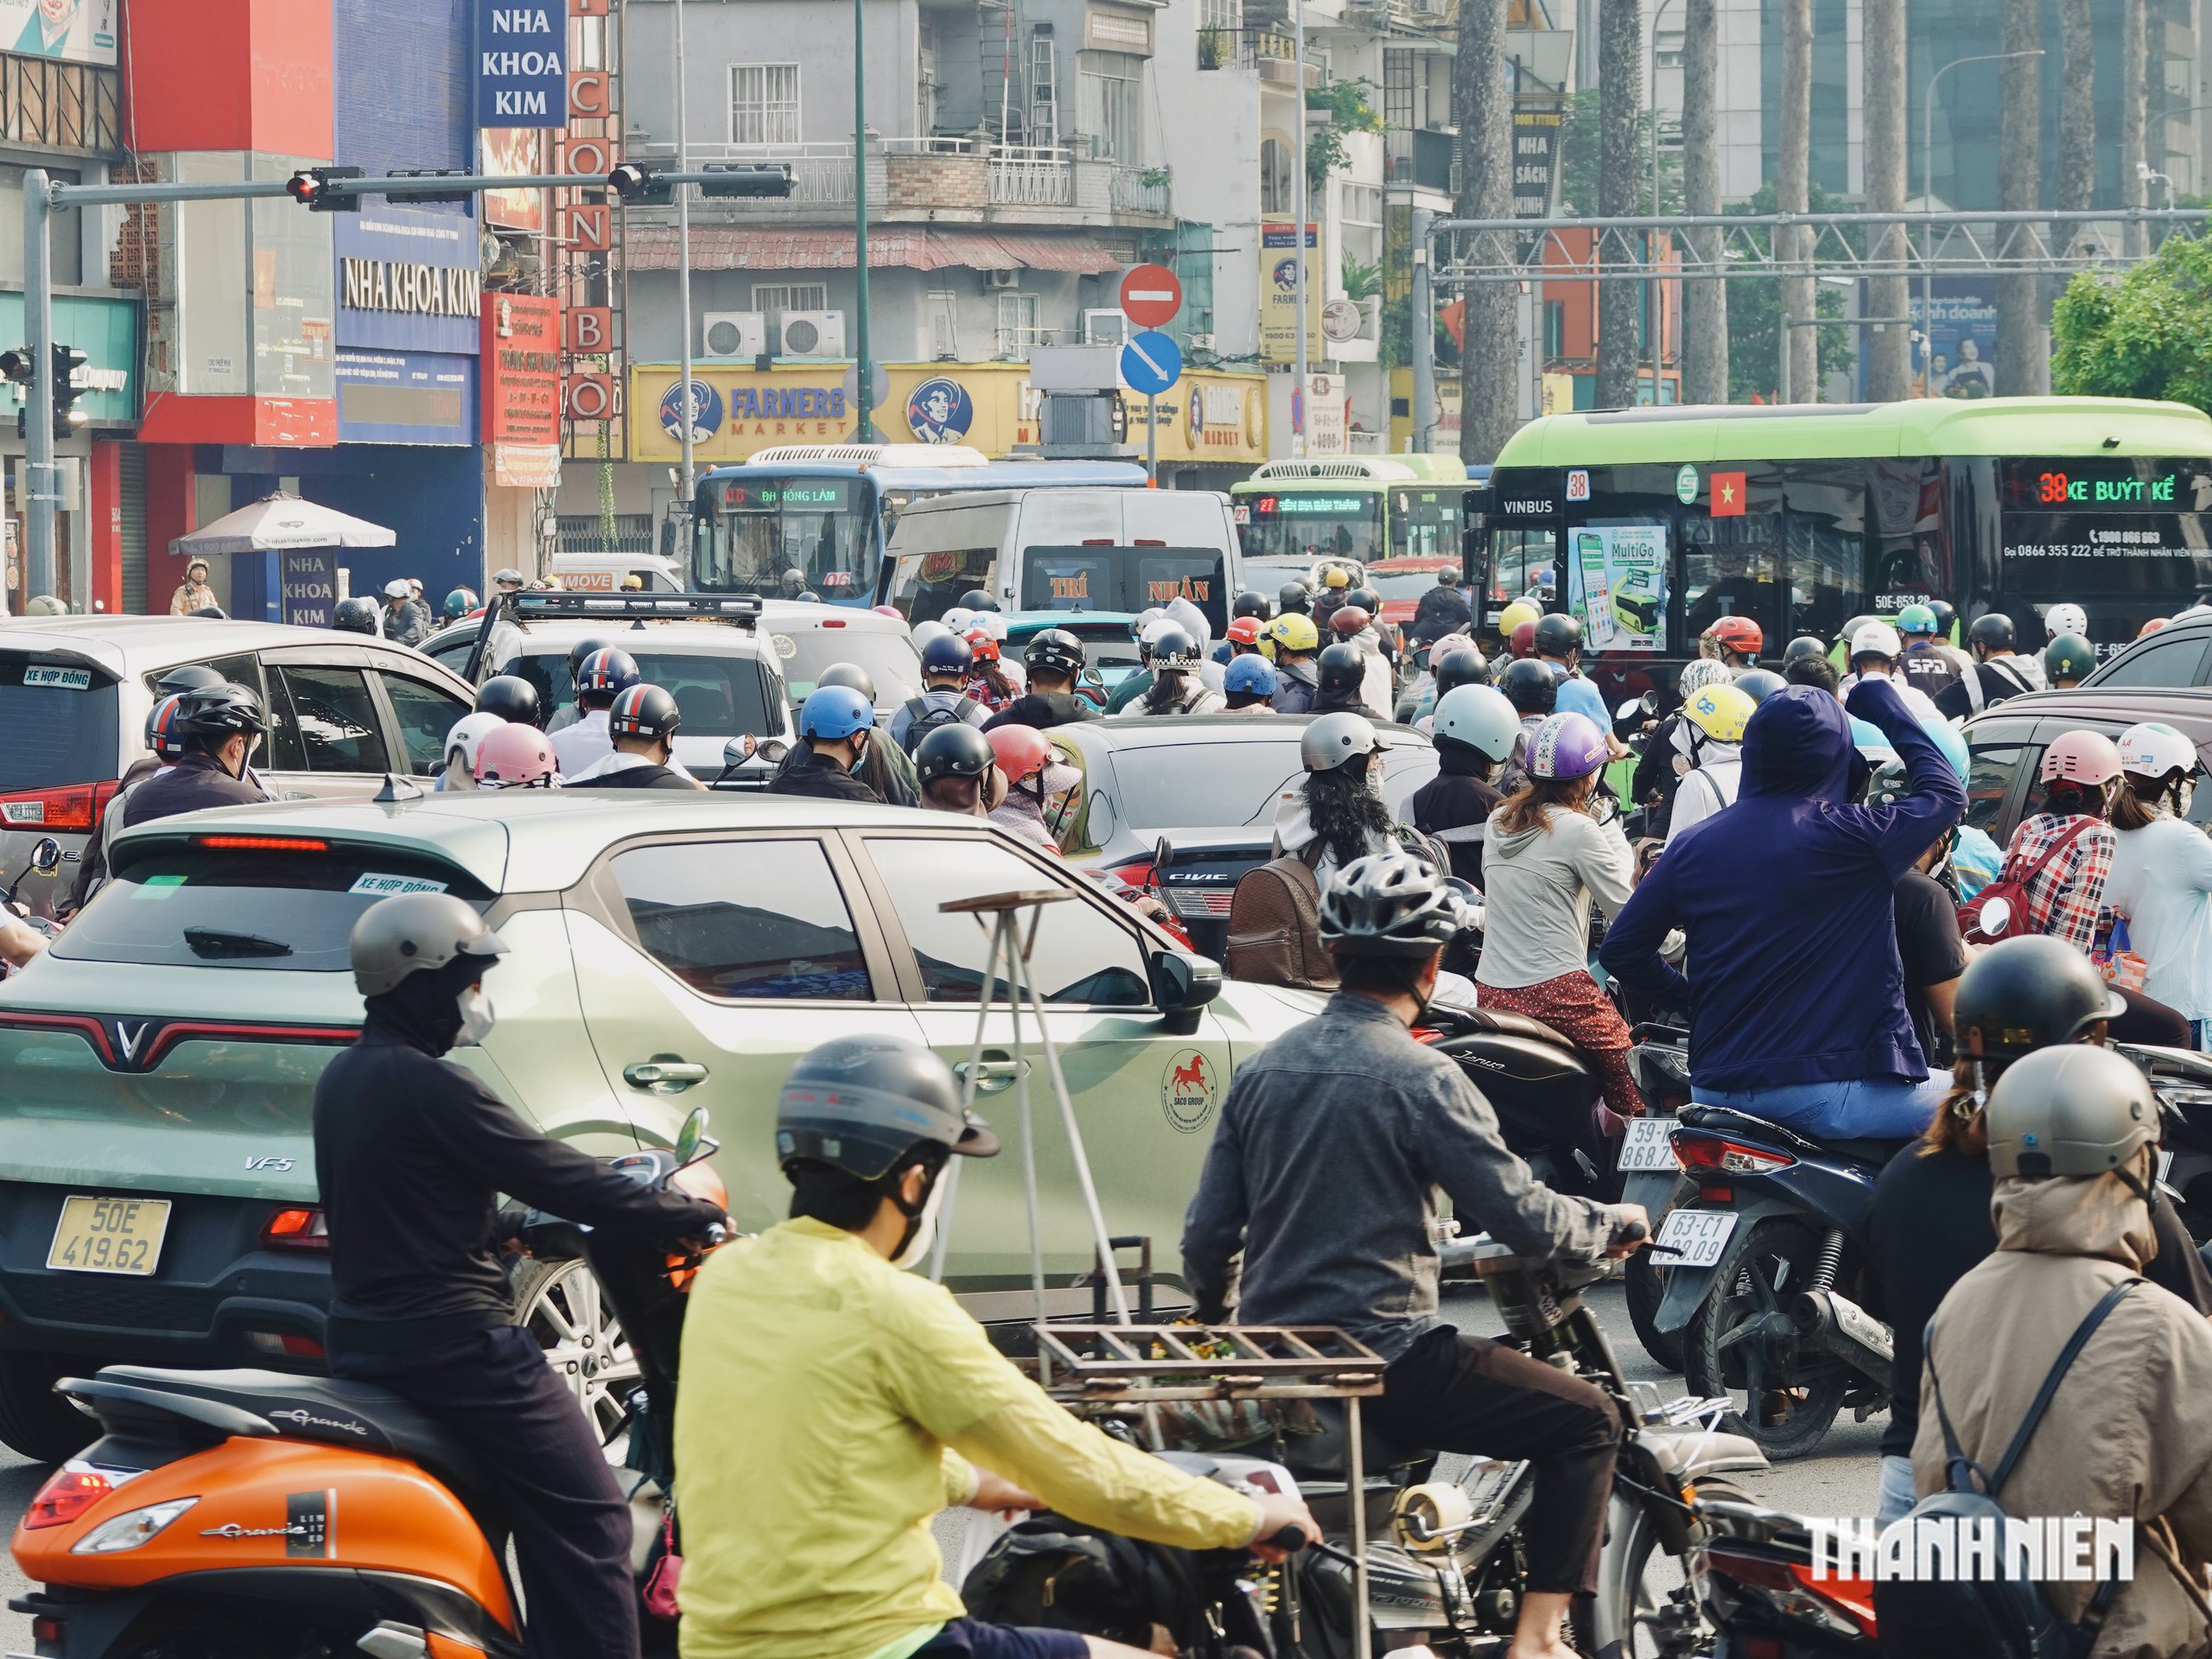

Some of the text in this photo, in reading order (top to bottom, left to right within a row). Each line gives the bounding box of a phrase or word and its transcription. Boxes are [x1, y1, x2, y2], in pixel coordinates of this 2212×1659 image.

[493, 10, 551, 33] NHA
[482, 52, 563, 75] KHOA
[496, 91, 547, 115] KIM
[1518, 137, 1548, 155] NHA
[1516, 162, 1548, 184] SÁCH
[1515, 196, 1543, 214] KINH
[344, 258, 480, 317] NHA KHOA KIM
[1273, 295, 1309, 304] FARMES
[731, 388, 845, 418] FARMERS
[732, 423, 847, 435] MARKET
[1204, 430, 1238, 446] MARKET
[1570, 474, 1586, 497] 38
[2039, 473, 2068, 503] 38
[2095, 477, 2145, 500] BUÝT
[1235, 508, 1249, 522] 27
[1504, 499, 1553, 513] VINBUS
[270, 537, 327, 547] nhakhoakim.com
[1611, 543, 1654, 557] MultiGo
[2004, 547, 2017, 559] Gọi
[2018, 546, 2046, 557] 0866
[2048, 545, 2069, 557] 355
[2071, 545, 2091, 557] 222
[2122, 545, 2150, 557] THÀNH
[2150, 546, 2173, 558] NHÂN
[289, 557, 325, 573] NHA
[824, 573, 850, 586] 06
[1050, 571, 1088, 600] TRÍ
[1147, 575, 1210, 602] NHÂN
[284, 583, 334, 599] KHOA
[1875, 594, 1930, 609] 50E-653.28
[292, 609, 326, 625] KIM
[25, 669, 89, 685] XE HỢP ĐỒNG
[1696, 693, 1716, 715] be
[359, 877, 378, 888] XE
[376, 879, 403, 893] HỢP
[1173, 1096, 1205, 1106] SACO GROUP
[245, 1155, 296, 1172] VF5
[90, 1202, 141, 1234] 50E
[1672, 1215, 1724, 1238] 63-C1
[62, 1236, 149, 1270] 419.62
[269, 1409, 368, 1435] Grande
[200, 1522, 308, 1540] Grande
